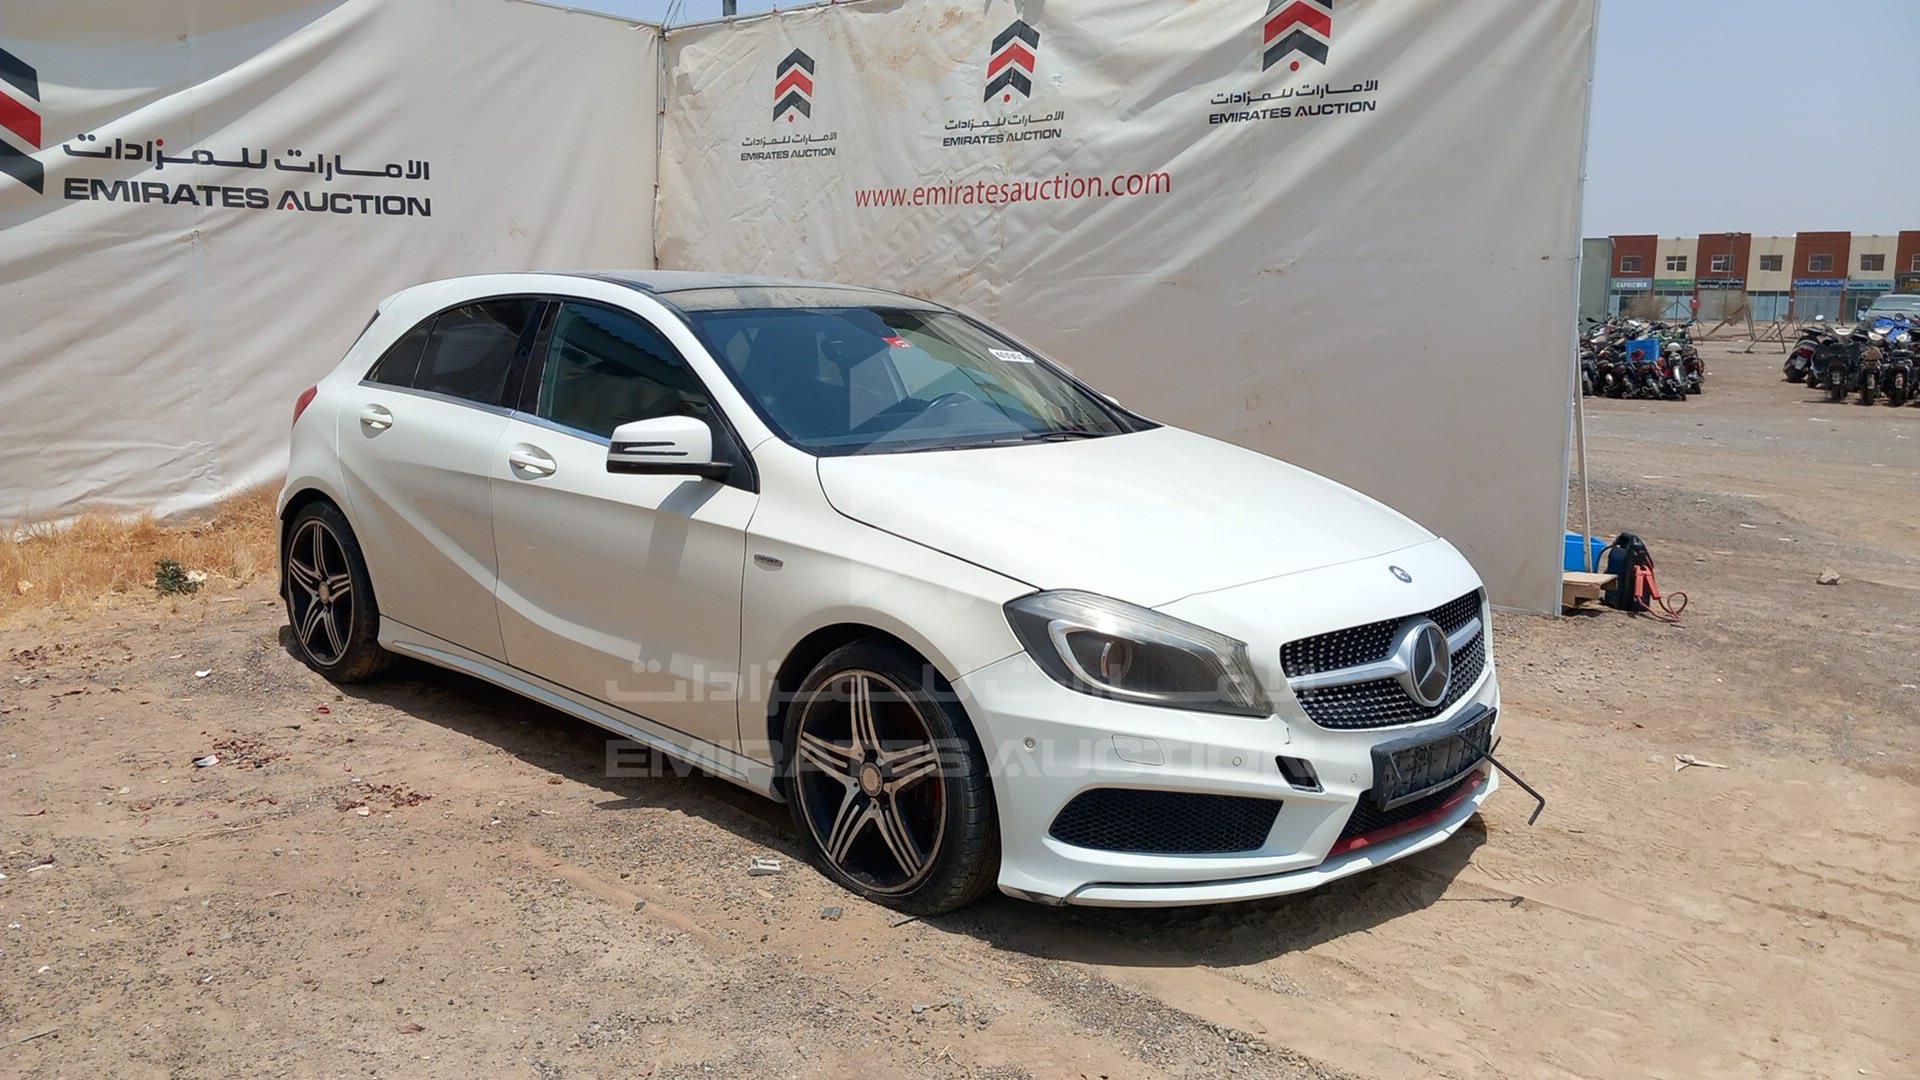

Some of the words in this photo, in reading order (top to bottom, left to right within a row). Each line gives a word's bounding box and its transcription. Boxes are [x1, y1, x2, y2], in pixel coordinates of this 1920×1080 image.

[1210, 87, 1294, 106] للمزادات
[1208, 106, 1292, 124] EMIRATES
[1294, 100, 1377, 117] AUCTION
[62, 133, 268, 170] للمزادات
[943, 133, 1005, 147] EMIRATES
[1005, 128, 1062, 143] AUCTION
[273, 149, 431, 181] الامارات
[740, 150, 790, 161] EMIRATES
[790, 147, 836, 159] AUCTION
[63, 176, 270, 210] EMIRATES
[275, 189, 432, 217] AUCTION
[854, 171, 1171, 208] www.emiratesauction.com
